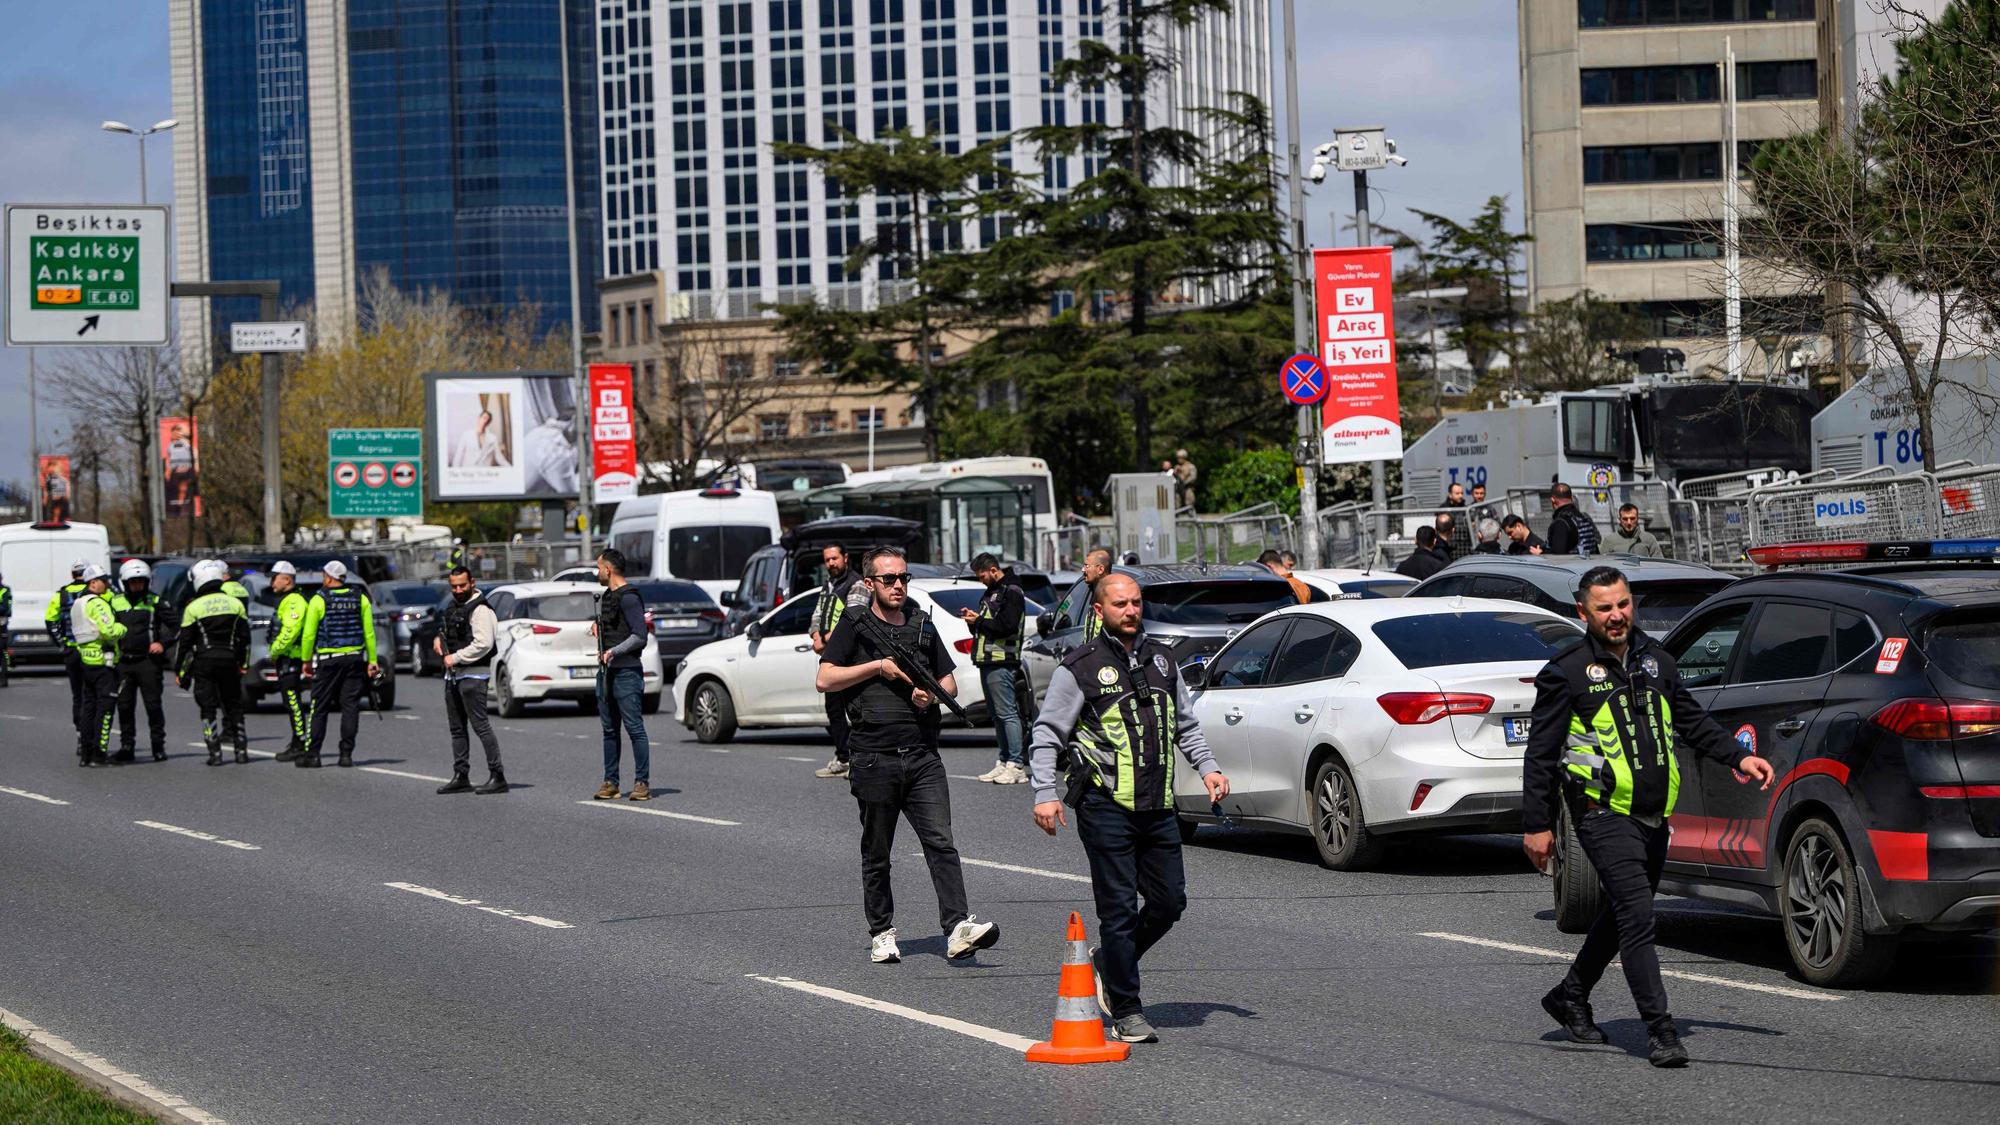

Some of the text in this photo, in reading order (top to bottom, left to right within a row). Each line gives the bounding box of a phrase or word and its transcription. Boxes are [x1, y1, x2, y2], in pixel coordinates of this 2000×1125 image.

[37, 214, 141, 231] Beşiktaş
[36, 242, 134, 263] Kadıköy
[37, 264, 125, 282] Ankara
[1344, 294, 1364, 306] Ev
[1337, 320, 1376, 334] Araç
[1332, 344, 1384, 364] İş Yeri
[1874, 431, 1887, 464] T
[1816, 498, 1866, 518] POLİS
[1884, 642, 1902, 658] 112
[1100, 685, 1124, 694] POLİS
[1588, 682, 1614, 694] POLİS
